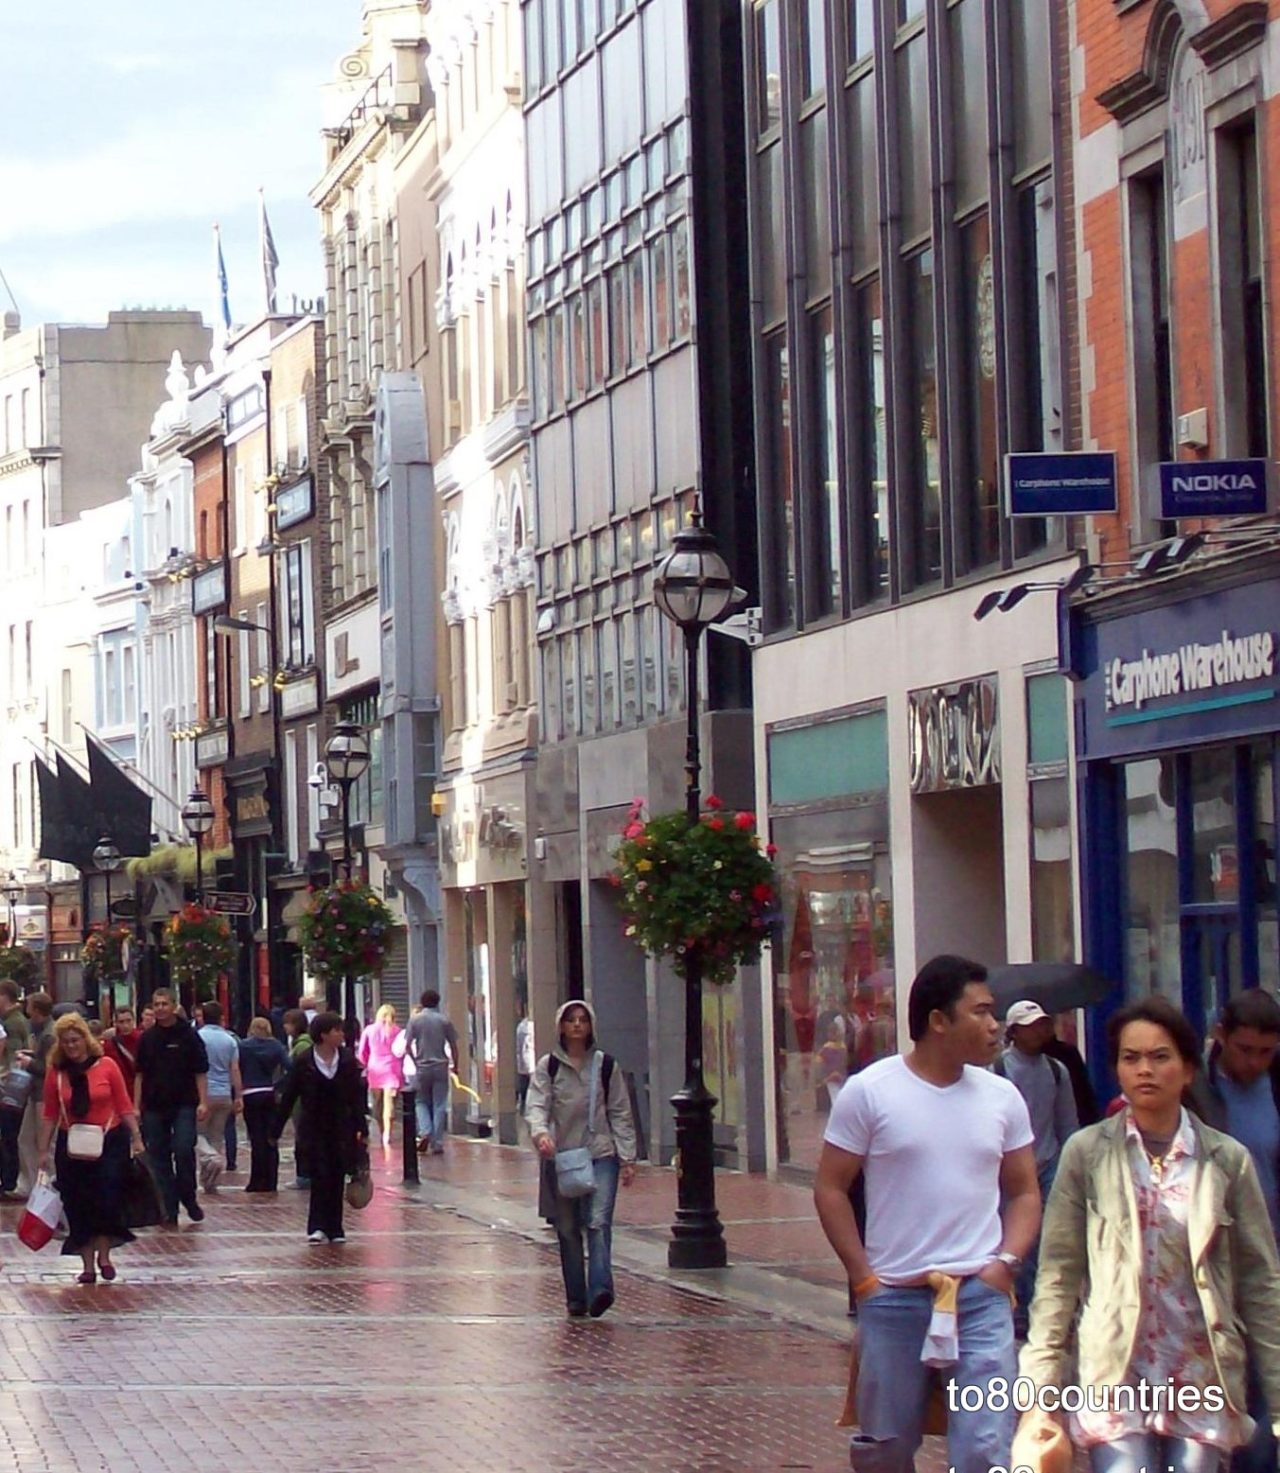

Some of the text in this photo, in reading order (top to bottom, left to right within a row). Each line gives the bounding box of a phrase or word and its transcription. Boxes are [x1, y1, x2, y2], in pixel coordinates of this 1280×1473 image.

[1172, 474, 1257, 493] NOKIA
[1112, 648, 1181, 710] Carphone
[1180, 629, 1273, 692] Warehouse
